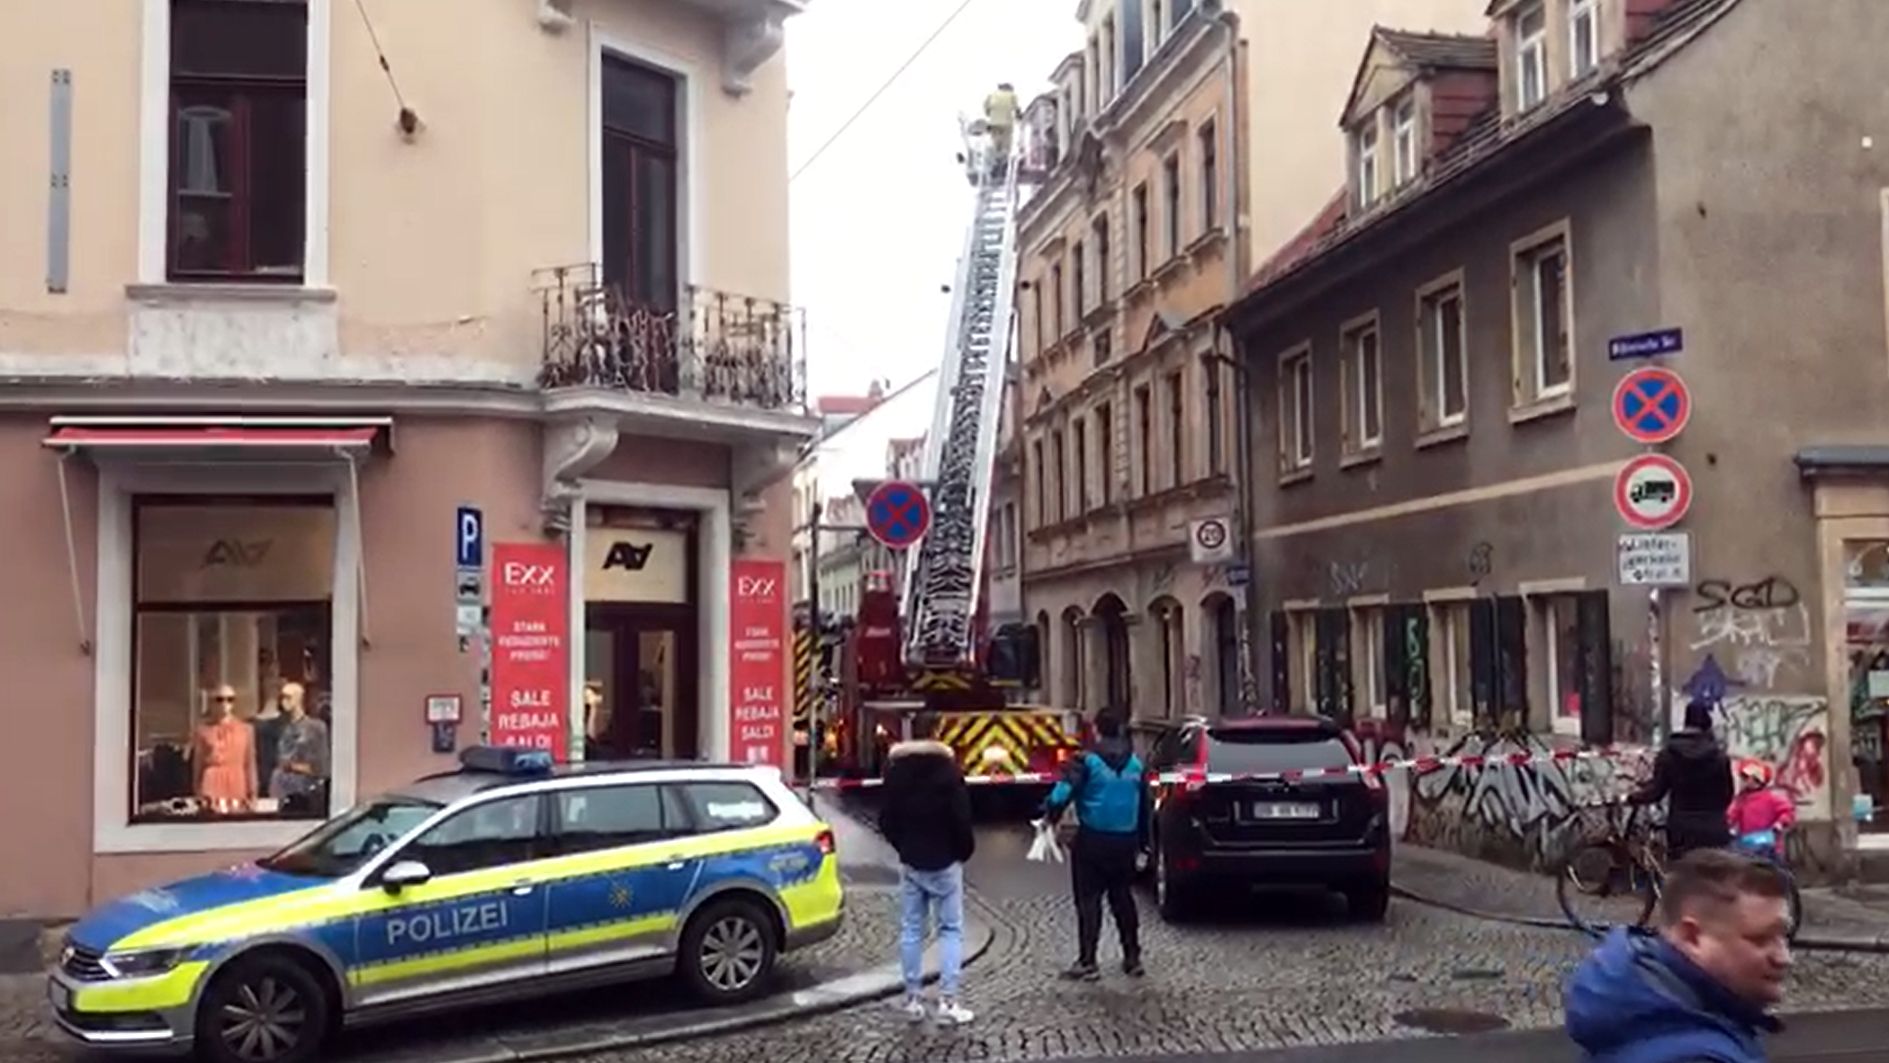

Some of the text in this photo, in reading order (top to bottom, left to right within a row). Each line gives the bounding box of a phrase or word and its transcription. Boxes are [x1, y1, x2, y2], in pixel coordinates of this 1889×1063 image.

[462, 513, 478, 560] P
[504, 561, 555, 586] EXX
[738, 576, 775, 596] EXX
[510, 690, 551, 708] SALE
[743, 686, 773, 701] SALE
[498, 711, 559, 730] REBAJA
[387, 900, 508, 945] POLIZEI
